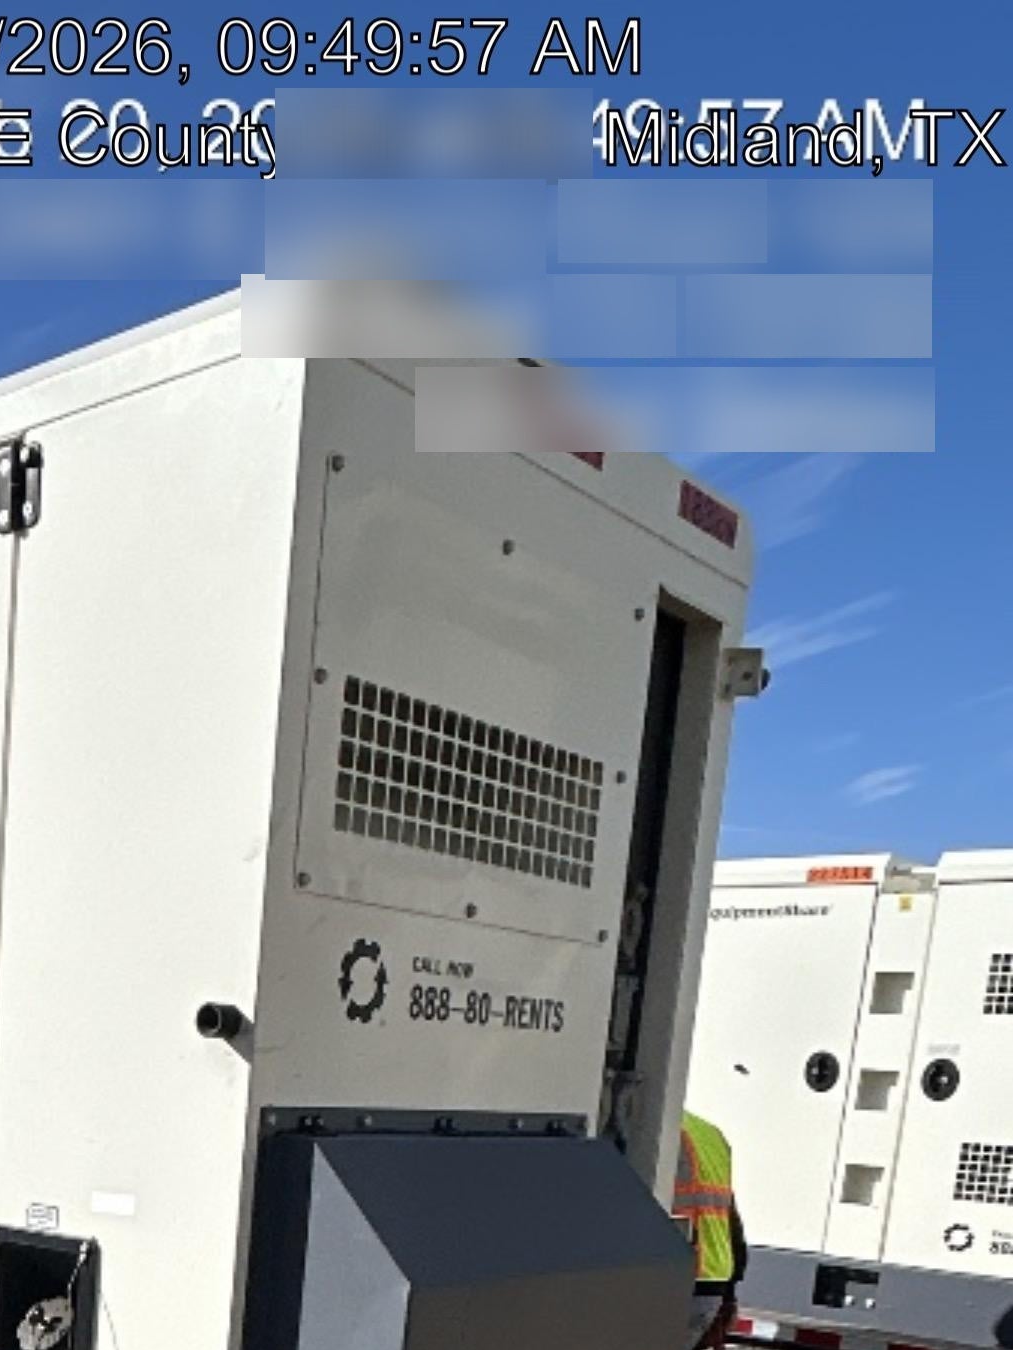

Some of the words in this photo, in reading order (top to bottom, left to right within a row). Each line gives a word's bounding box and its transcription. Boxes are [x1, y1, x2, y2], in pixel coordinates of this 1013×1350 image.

[710, 904, 829, 921] quipmentShare
[412, 956, 442, 976] CALL
[409, 984, 565, 1032] 888-80-RENTS
